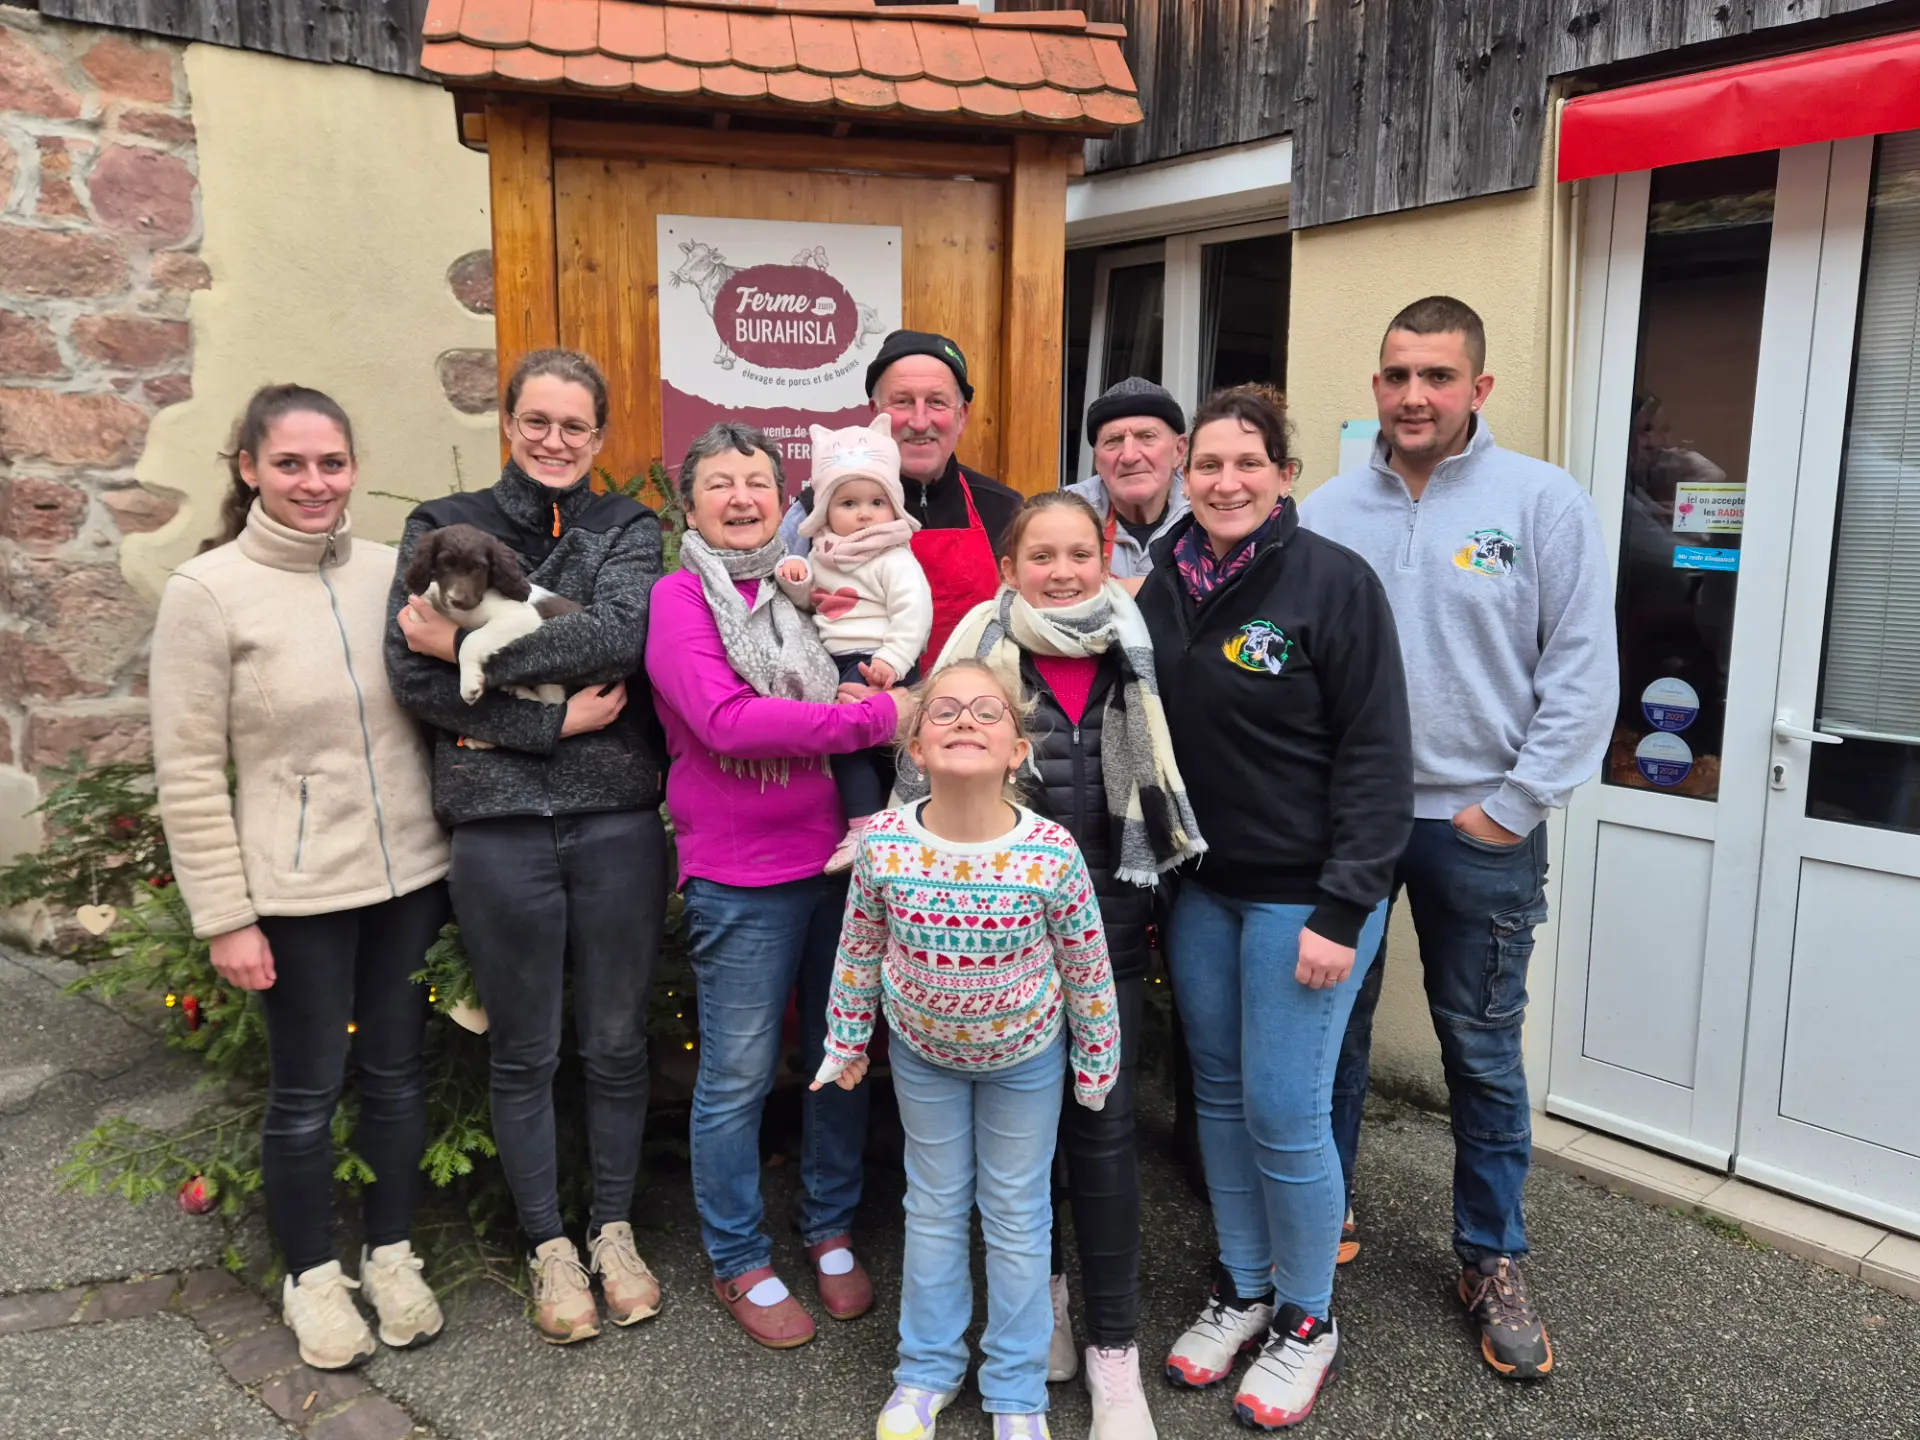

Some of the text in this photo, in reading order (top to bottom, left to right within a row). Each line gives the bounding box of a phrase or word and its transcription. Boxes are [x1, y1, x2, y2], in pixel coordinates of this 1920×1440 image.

[736, 286, 811, 313] Ferme
[735, 318, 836, 345] BURAHISLA
[776, 377, 786, 386] de
[788, 379, 811, 388] porcs
[813, 376, 822, 384] et
[823, 373, 834, 381] de
[835, 359, 859, 377] bovins
[763, 425, 807, 438] vente de
[787, 443, 811, 460] FER
[1711, 497, 1746, 506] accepte
[1703, 508, 1745, 517] les RADIS
